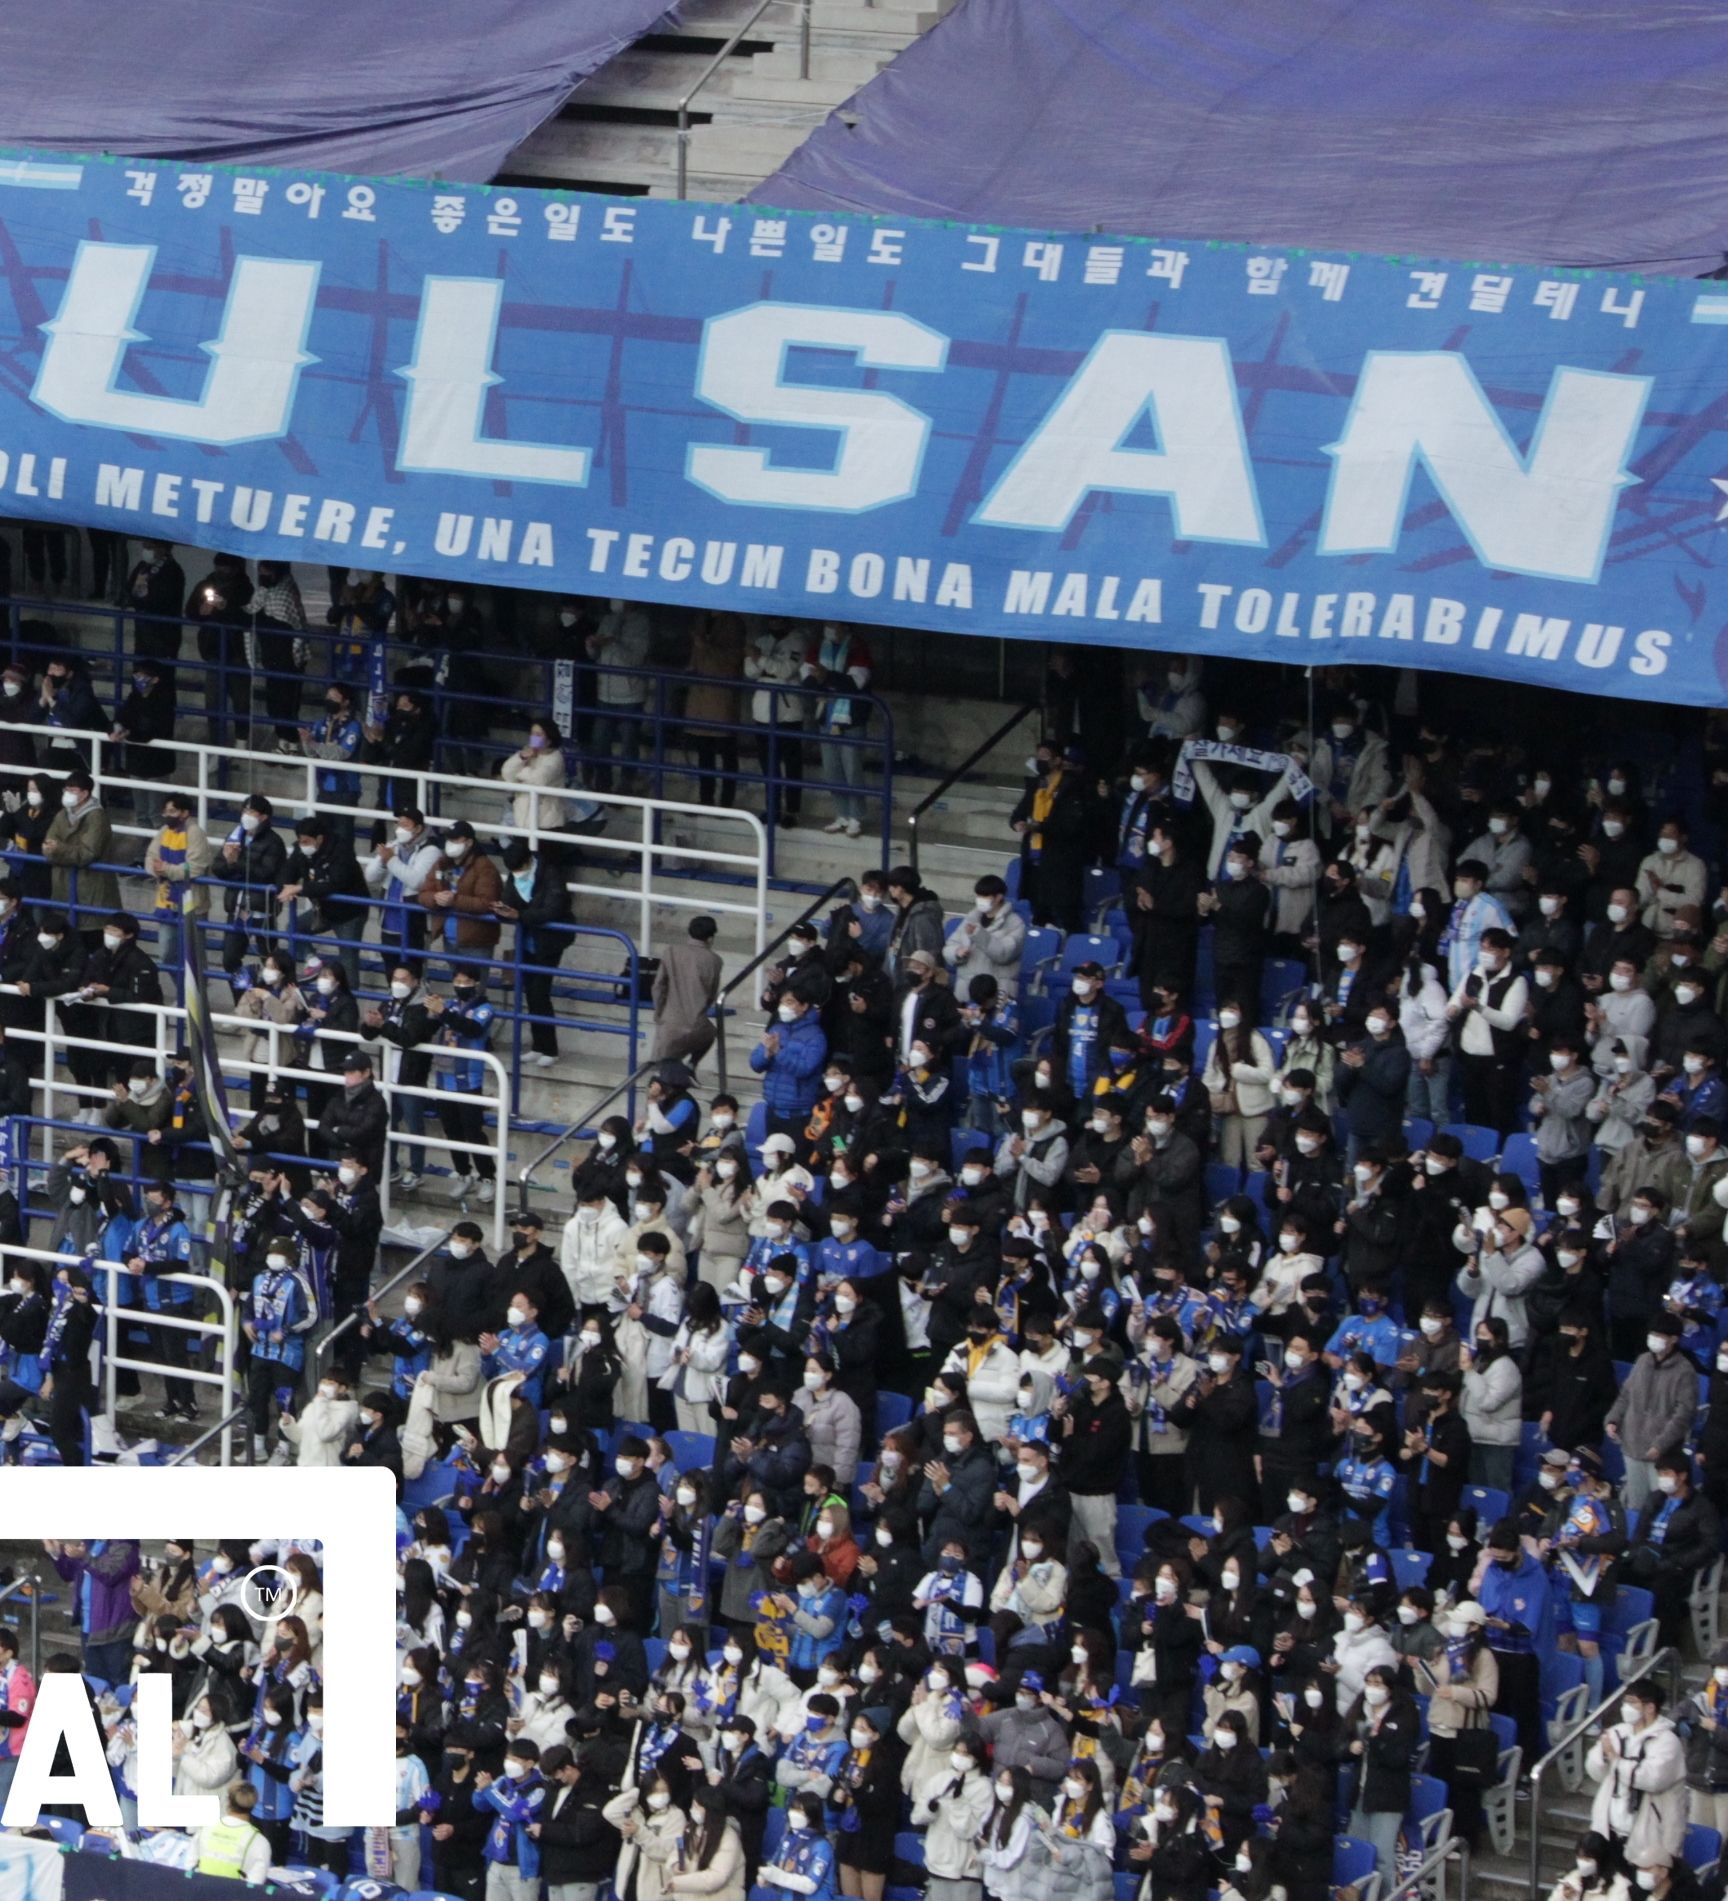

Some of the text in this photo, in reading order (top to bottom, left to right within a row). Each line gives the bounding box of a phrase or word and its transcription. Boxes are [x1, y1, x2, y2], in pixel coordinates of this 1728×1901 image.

[123, 170, 1646, 329] 걱정말아요 좋은일도 나쁜일도 그대들과 함께 견딜테니
[29, 240, 1656, 585] ULSAN
[94, 463, 406, 556] METUERE,
[433, 511, 555, 568] UNA
[586, 527, 785, 590] TECUM
[804, 548, 974, 609] BONA
[1002, 569, 1163, 625] MALA
[1196, 582, 1673, 677] TOLERABIMUS
